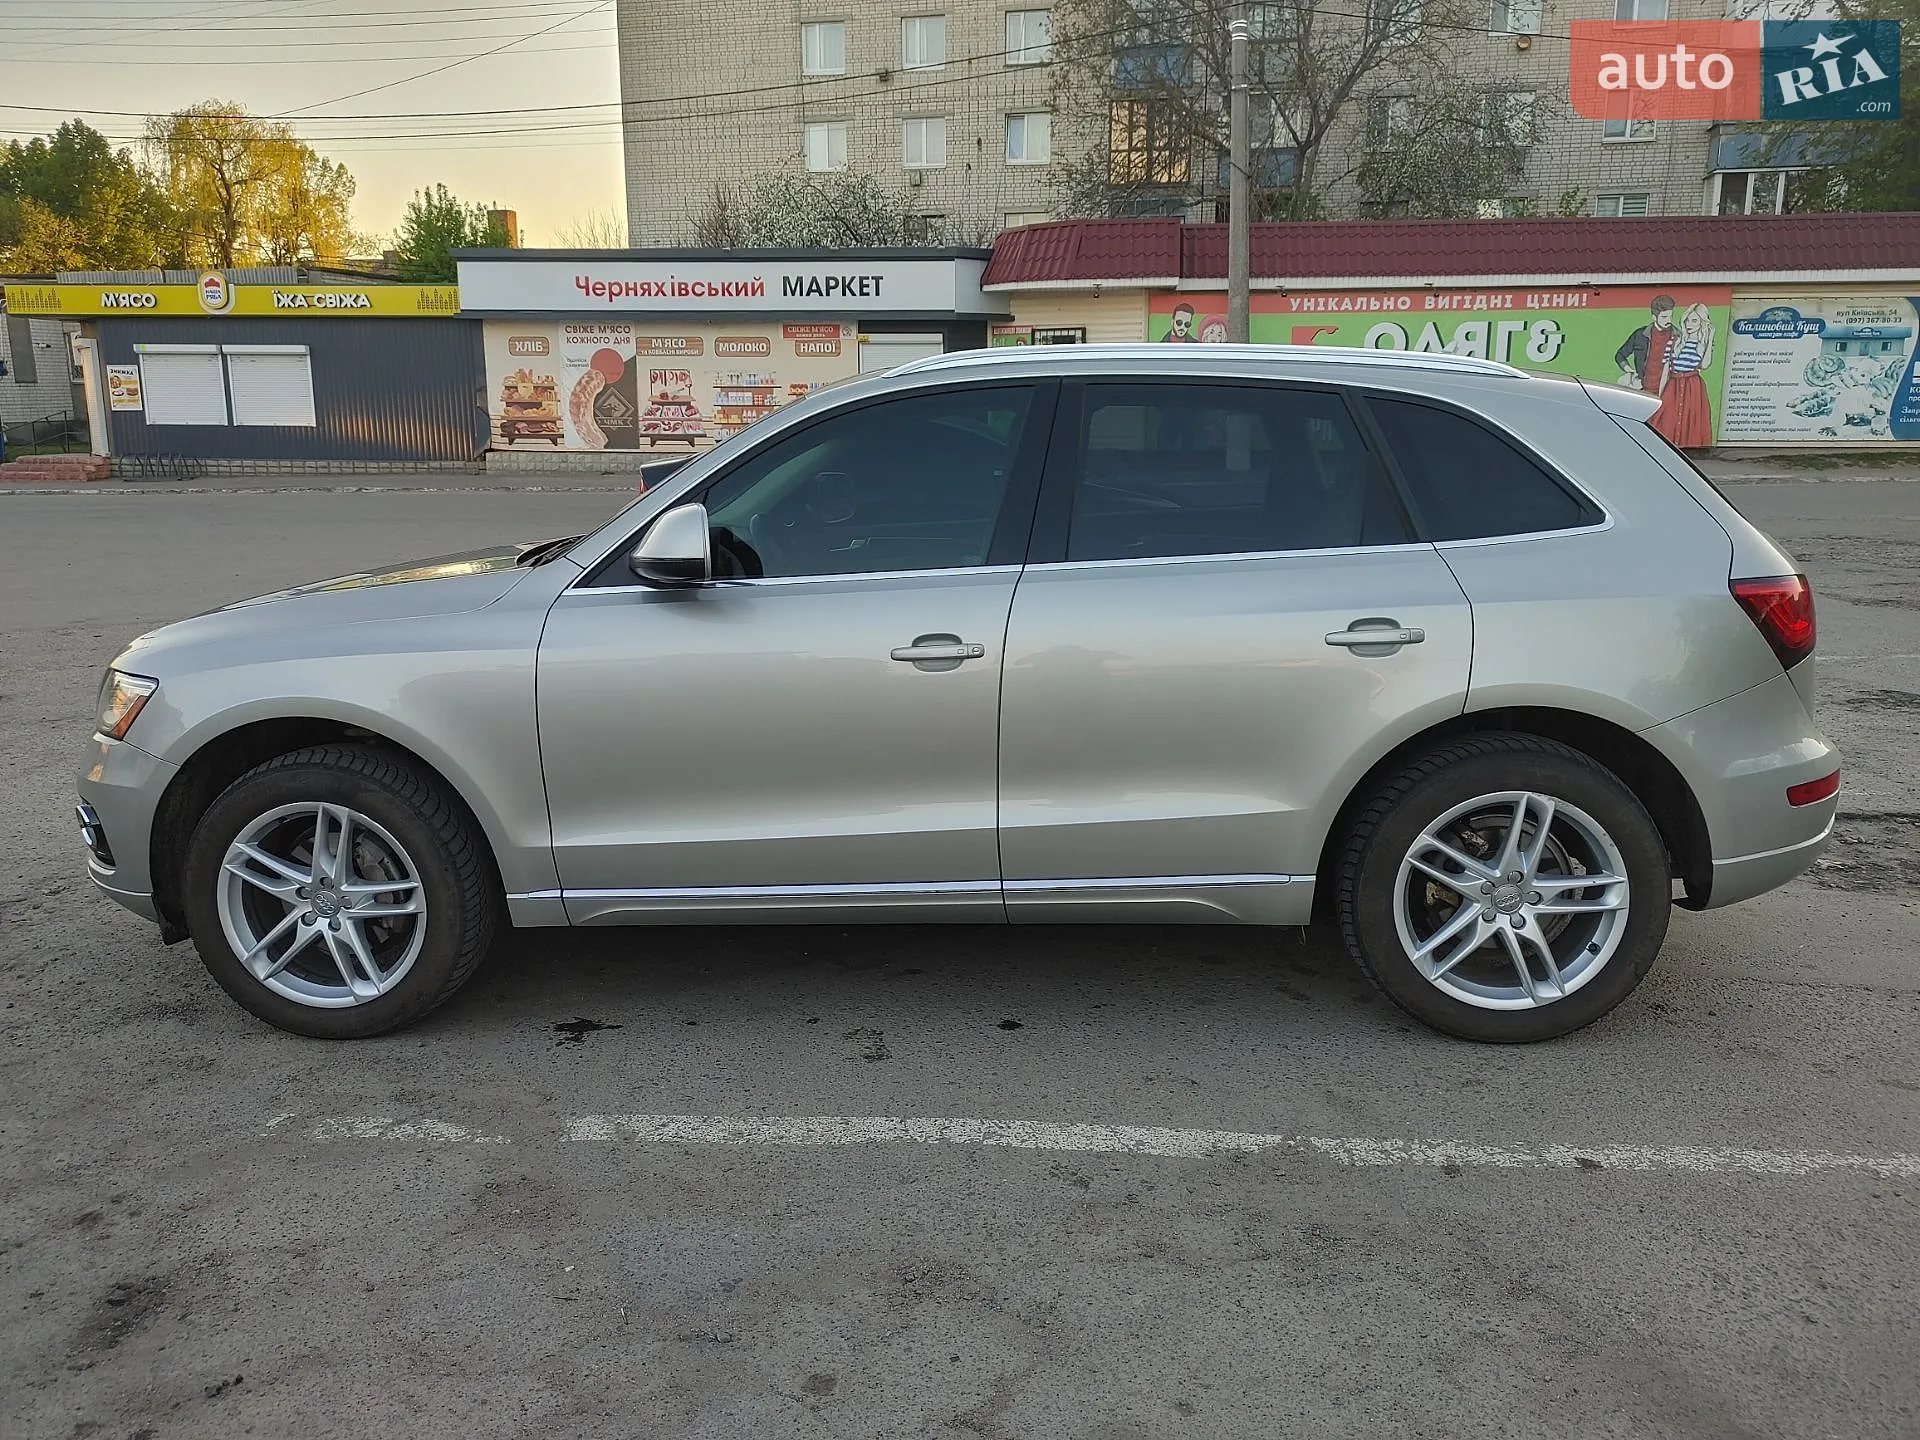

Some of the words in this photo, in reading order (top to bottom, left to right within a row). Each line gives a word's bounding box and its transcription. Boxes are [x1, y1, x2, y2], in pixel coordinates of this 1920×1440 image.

[575, 275, 765, 302] Черняхівський
[782, 275, 884, 297] МАРКЕТ
[101, 293, 156, 308] М'ЯСО
[272, 290, 309, 308] ЇЖА
[313, 293, 371, 308] СВІЖА
[1290, 296, 1411, 312] УНІКАЛЬНО
[1424, 293, 1513, 309] ВИГІДНІ
[1526, 293, 1588, 309] ЦІНИ!
[565, 325, 594, 334] СВІЖЕ
[598, 325, 631, 334] М'ЯСО
[1738, 320, 1794, 331] Калиновий
[1796, 320, 1820, 333] Кущ
[515, 341, 543, 352] ХЛІБ
[566, 336, 610, 345] КОЖНОГО
[613, 336, 631, 345] ДНЯ
[651, 338, 686, 348] М'ЯСО
[800, 340, 836, 352] НАПОЇ
[719, 342, 767, 352] МОЛОКО
